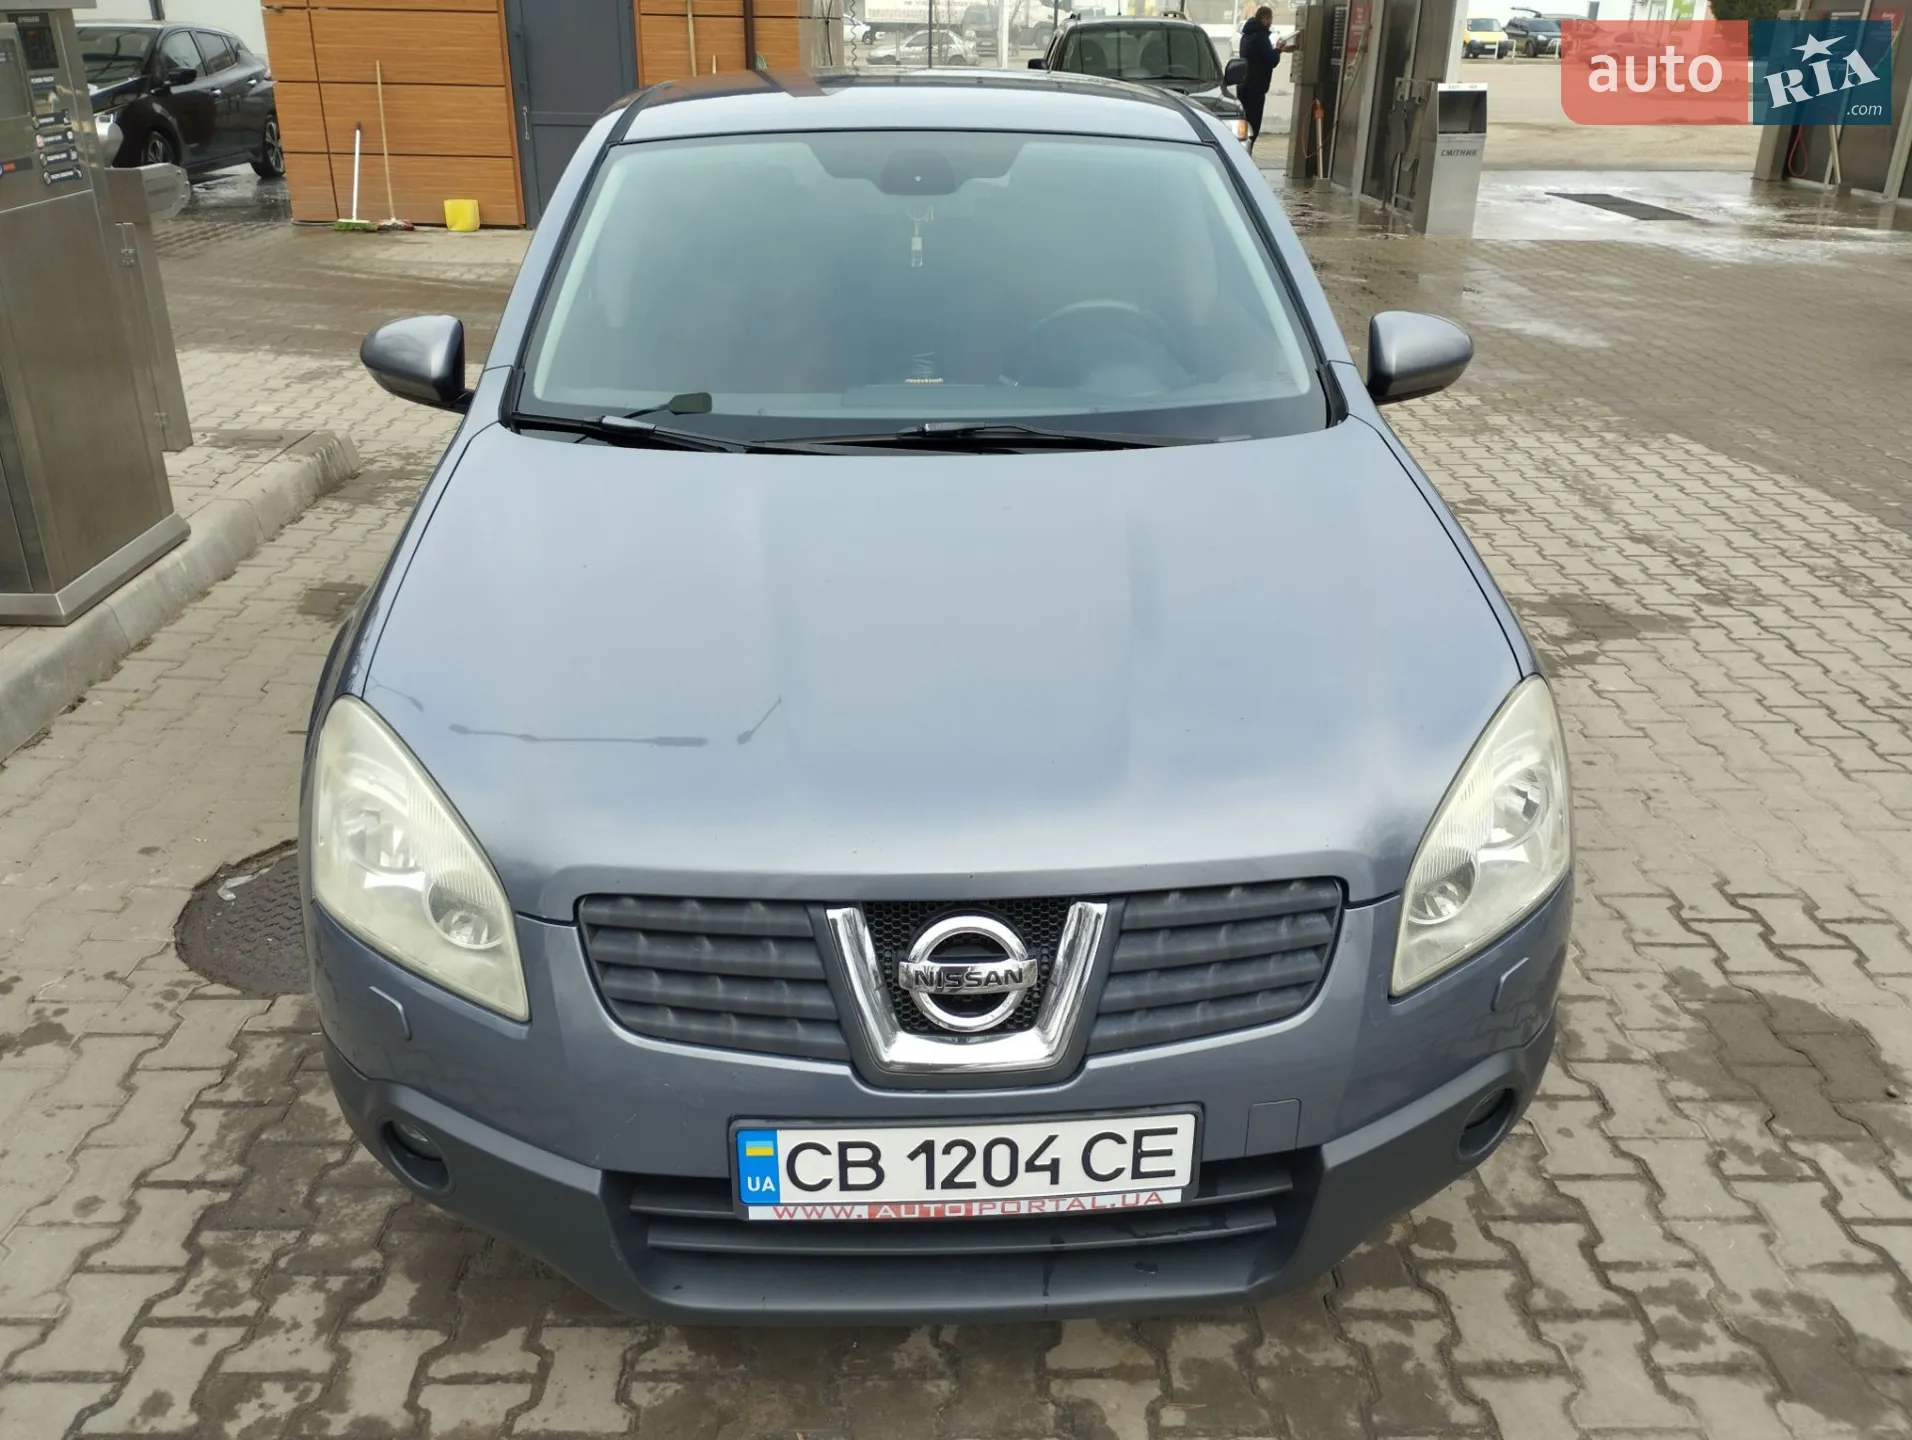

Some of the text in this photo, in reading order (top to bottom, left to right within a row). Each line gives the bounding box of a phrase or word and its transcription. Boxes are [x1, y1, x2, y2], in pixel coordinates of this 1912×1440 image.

[914, 967, 1024, 989] NISSAN
[786, 1126, 1179, 1192] CB 1204 CE
[747, 1176, 776, 1192] UA
